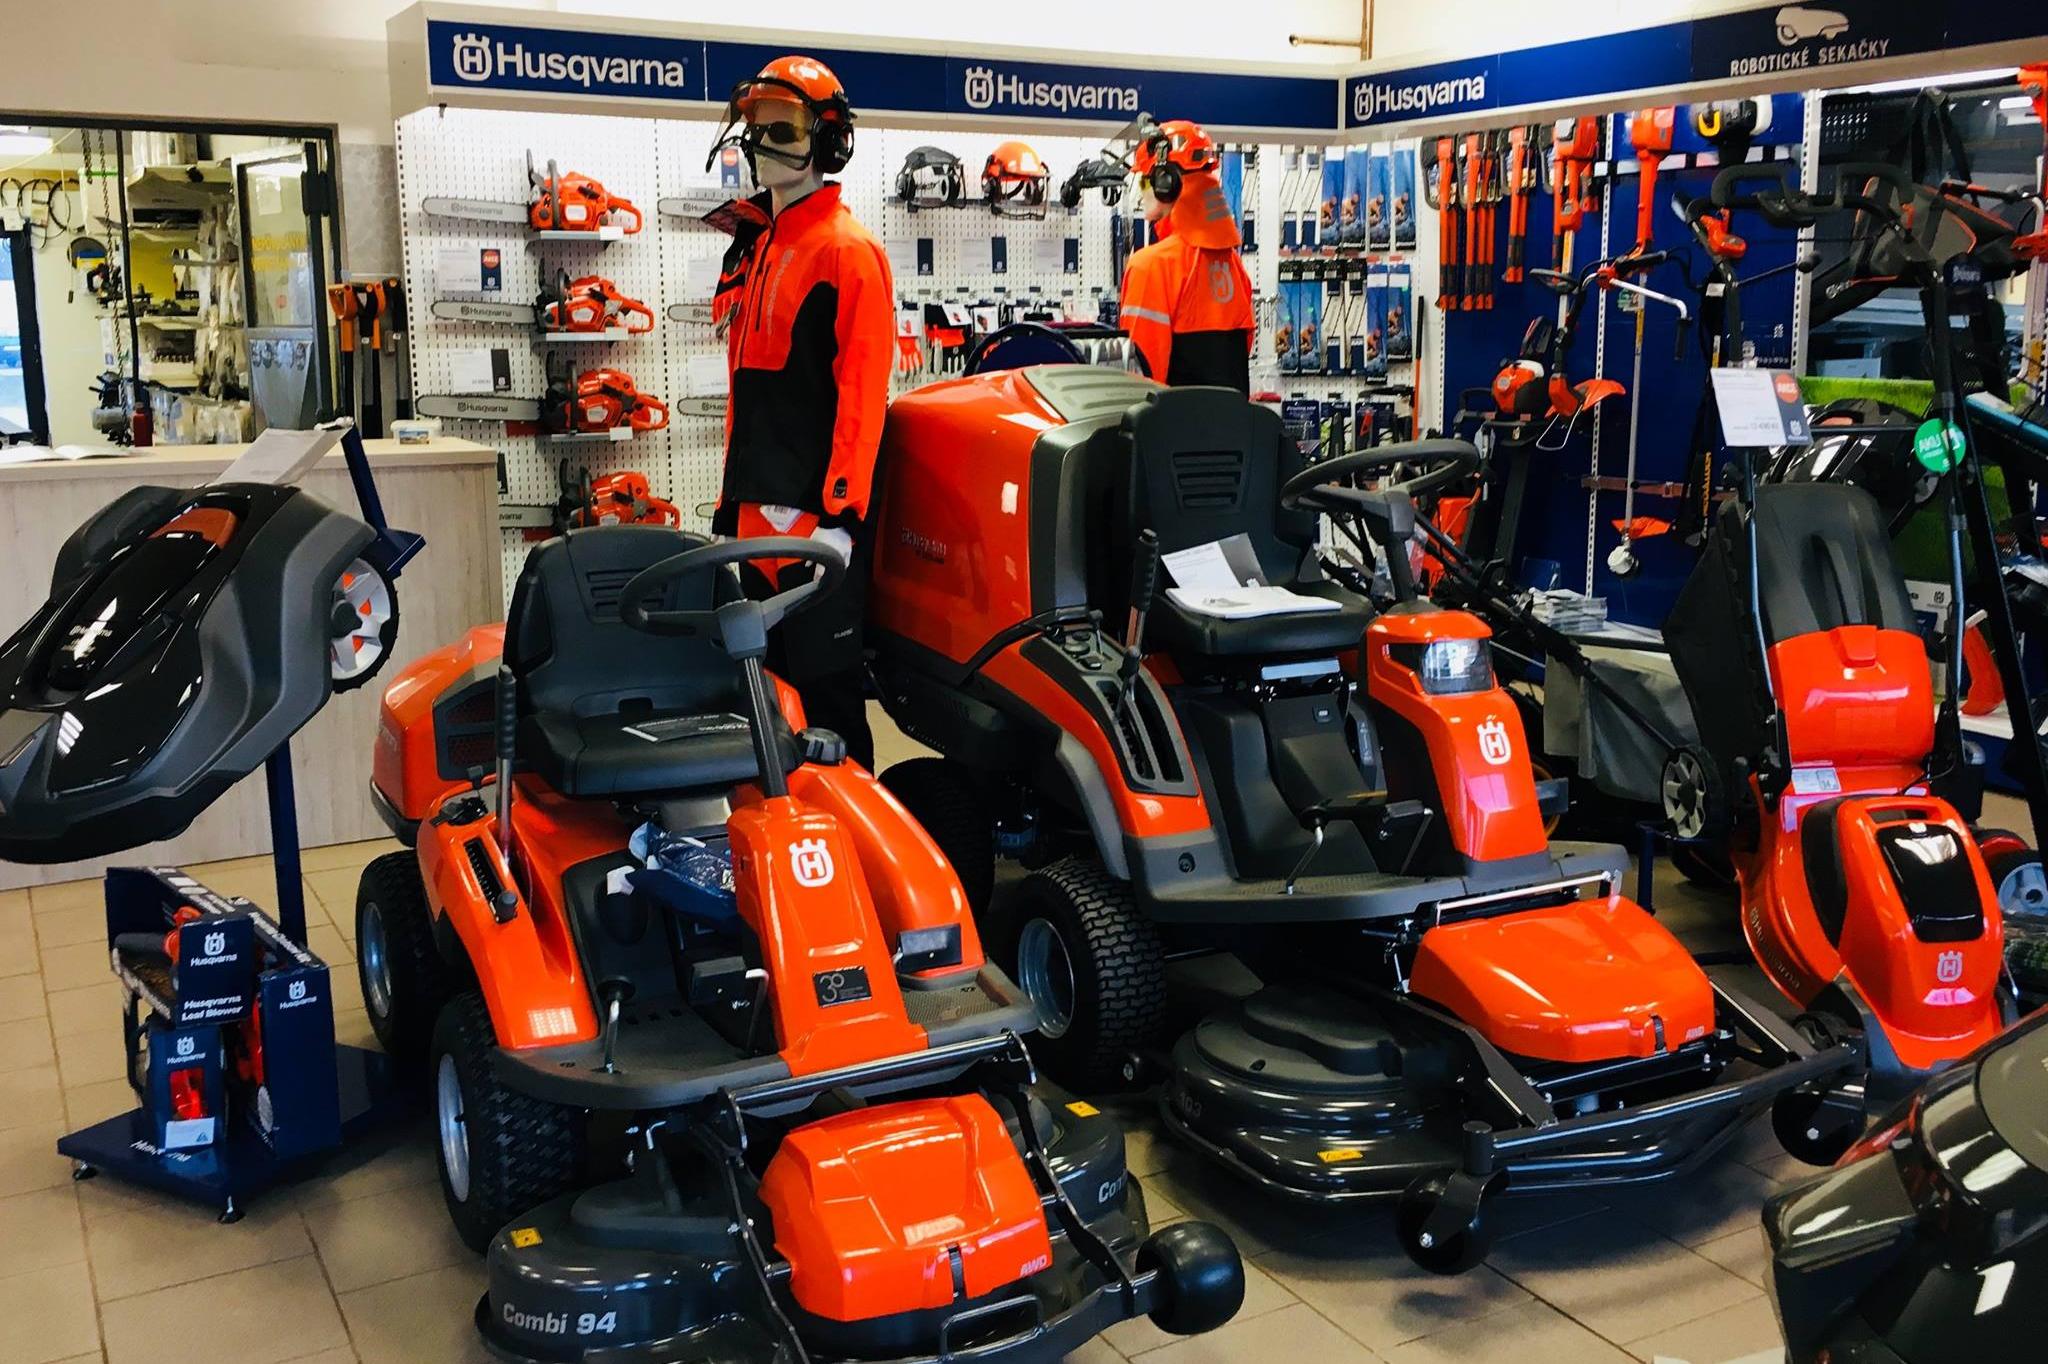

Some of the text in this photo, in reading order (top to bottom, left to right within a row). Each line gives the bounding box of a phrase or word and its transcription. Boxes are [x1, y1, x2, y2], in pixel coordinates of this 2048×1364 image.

[496, 41, 685, 88] Husqvarna
[1730, 38, 1890, 77] ROBOTICKÉ SEKAČKY
[996, 76, 1139, 113] Husqvarna
[1375, 74, 1486, 115] Husqvarna
[469, 306, 513, 318] Husqvarna
[466, 402, 509, 415] Husqvarna
[190, 953, 238, 968] Husqvarna
[184, 994, 242, 1012] Husqvarna
[279, 995, 318, 1010] Husqvarna
[181, 1005, 244, 1022] Leaf Blower
[166, 1052, 206, 1066] Husqvarna
[1019, 1254, 1048, 1278] AWD
[502, 1302, 617, 1335] Combi 94
